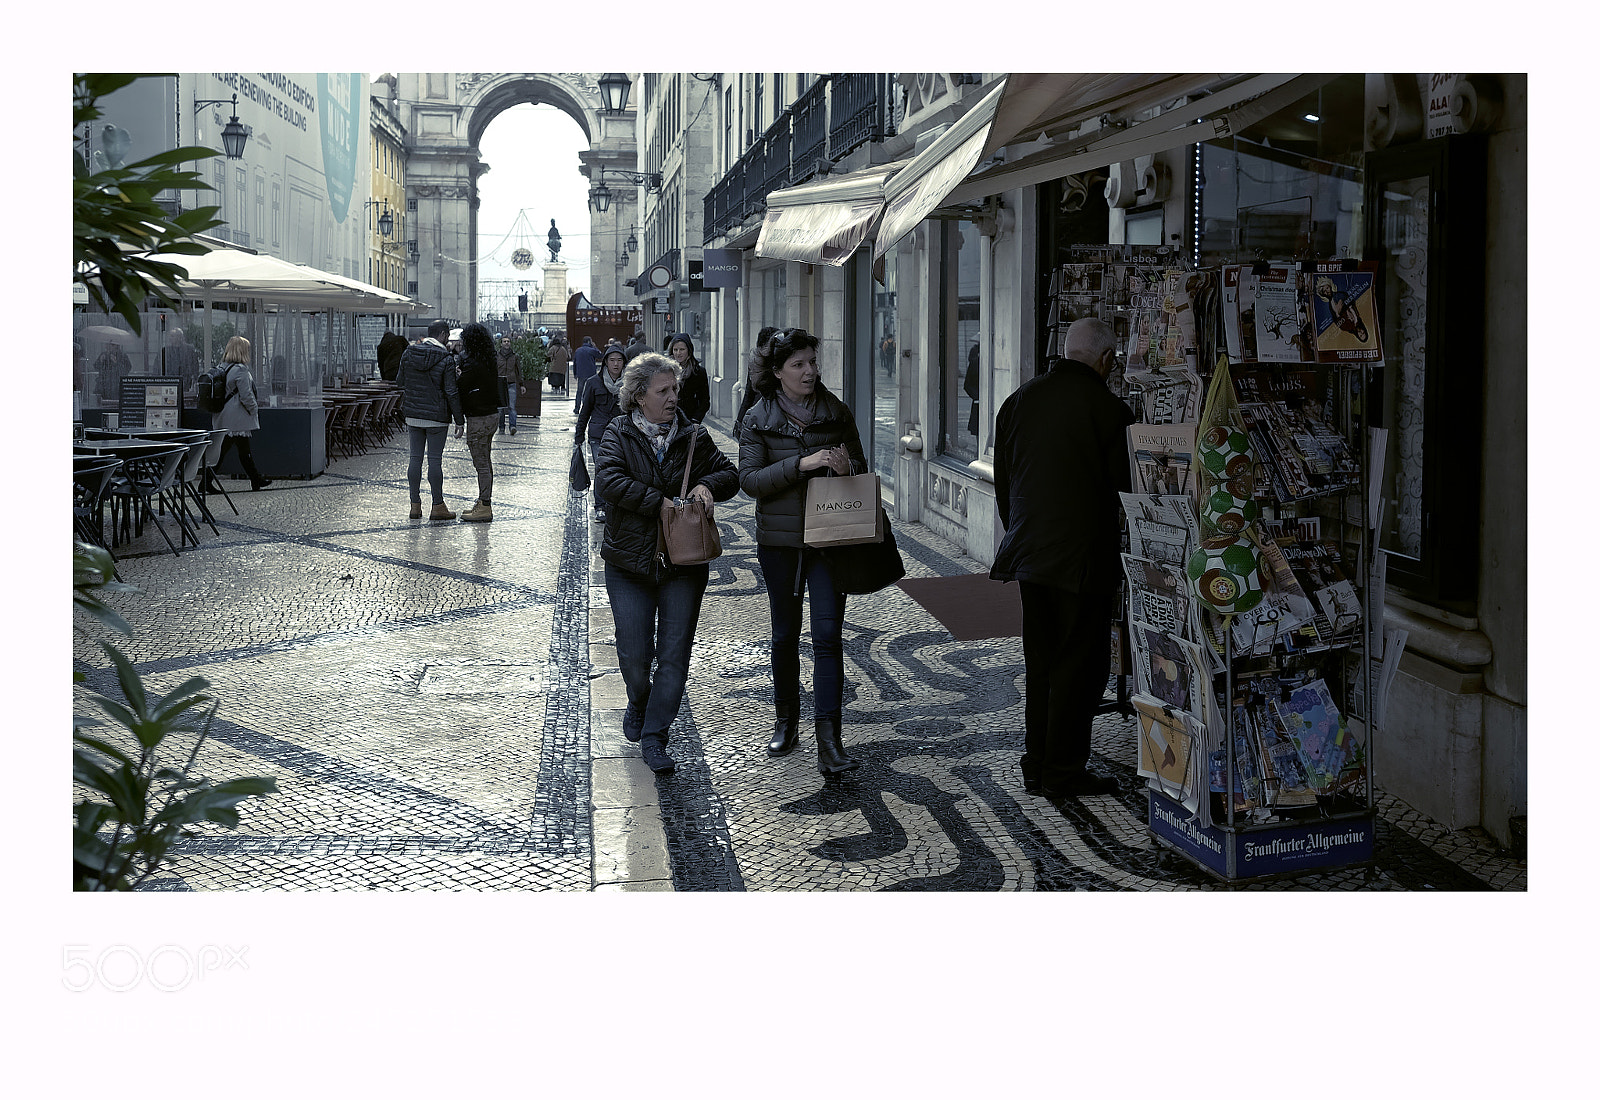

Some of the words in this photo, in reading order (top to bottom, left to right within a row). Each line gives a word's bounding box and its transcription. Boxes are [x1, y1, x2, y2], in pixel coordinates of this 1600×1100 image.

[240, 75, 271, 111] RENEWING
[273, 97, 283, 118] THE
[283, 104, 307, 132] BUILDING
[288, 80, 292, 97] O
[293, 83, 315, 112] EDIFÍCIO
[328, 99, 350, 152] MUDE
[1123, 254, 1158, 265] Lisboa
[816, 500, 862, 512] MANGO
[1244, 595, 1289, 620] OVERNIGHT
[1154, 801, 1187, 834] Frankfurter
[1186, 821, 1222, 855] Allgemeine
[1244, 838, 1305, 862] Frankfurter
[1304, 828, 1365, 854] Allgemeine
